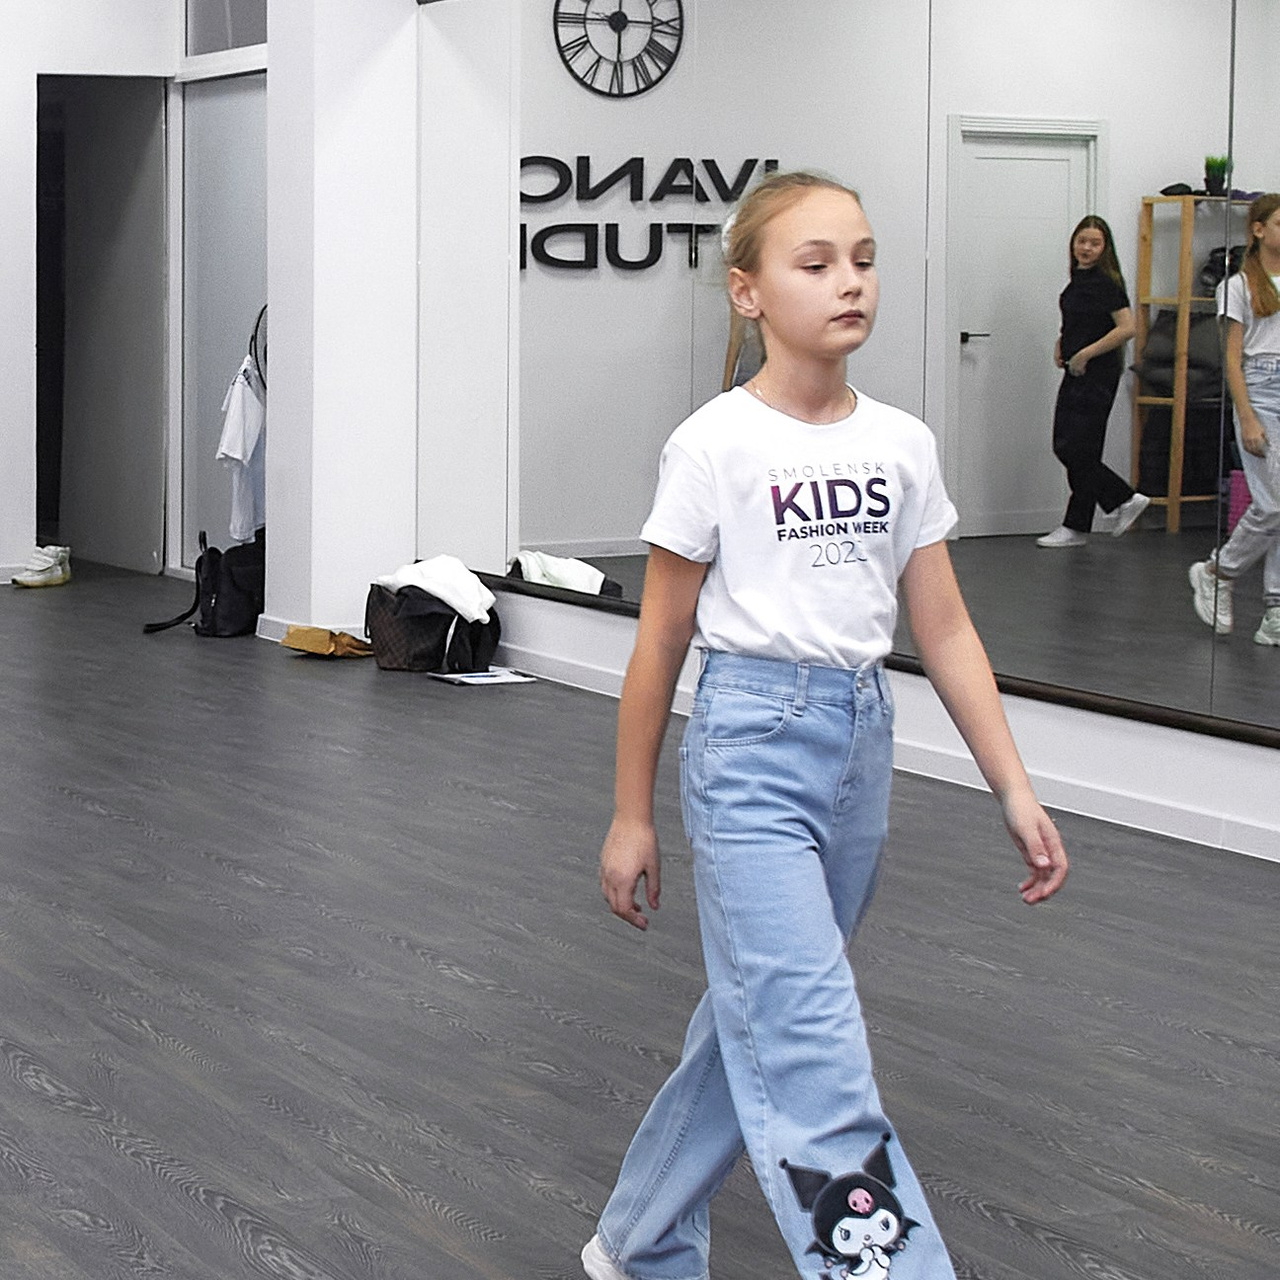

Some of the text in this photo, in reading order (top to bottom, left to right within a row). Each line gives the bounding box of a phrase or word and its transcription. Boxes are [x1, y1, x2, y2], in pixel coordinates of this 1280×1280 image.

[768, 462, 885, 482] SMOLENSK
[770, 477, 890, 525] KIDS
[777, 521, 888, 541] FASHION WEEK
